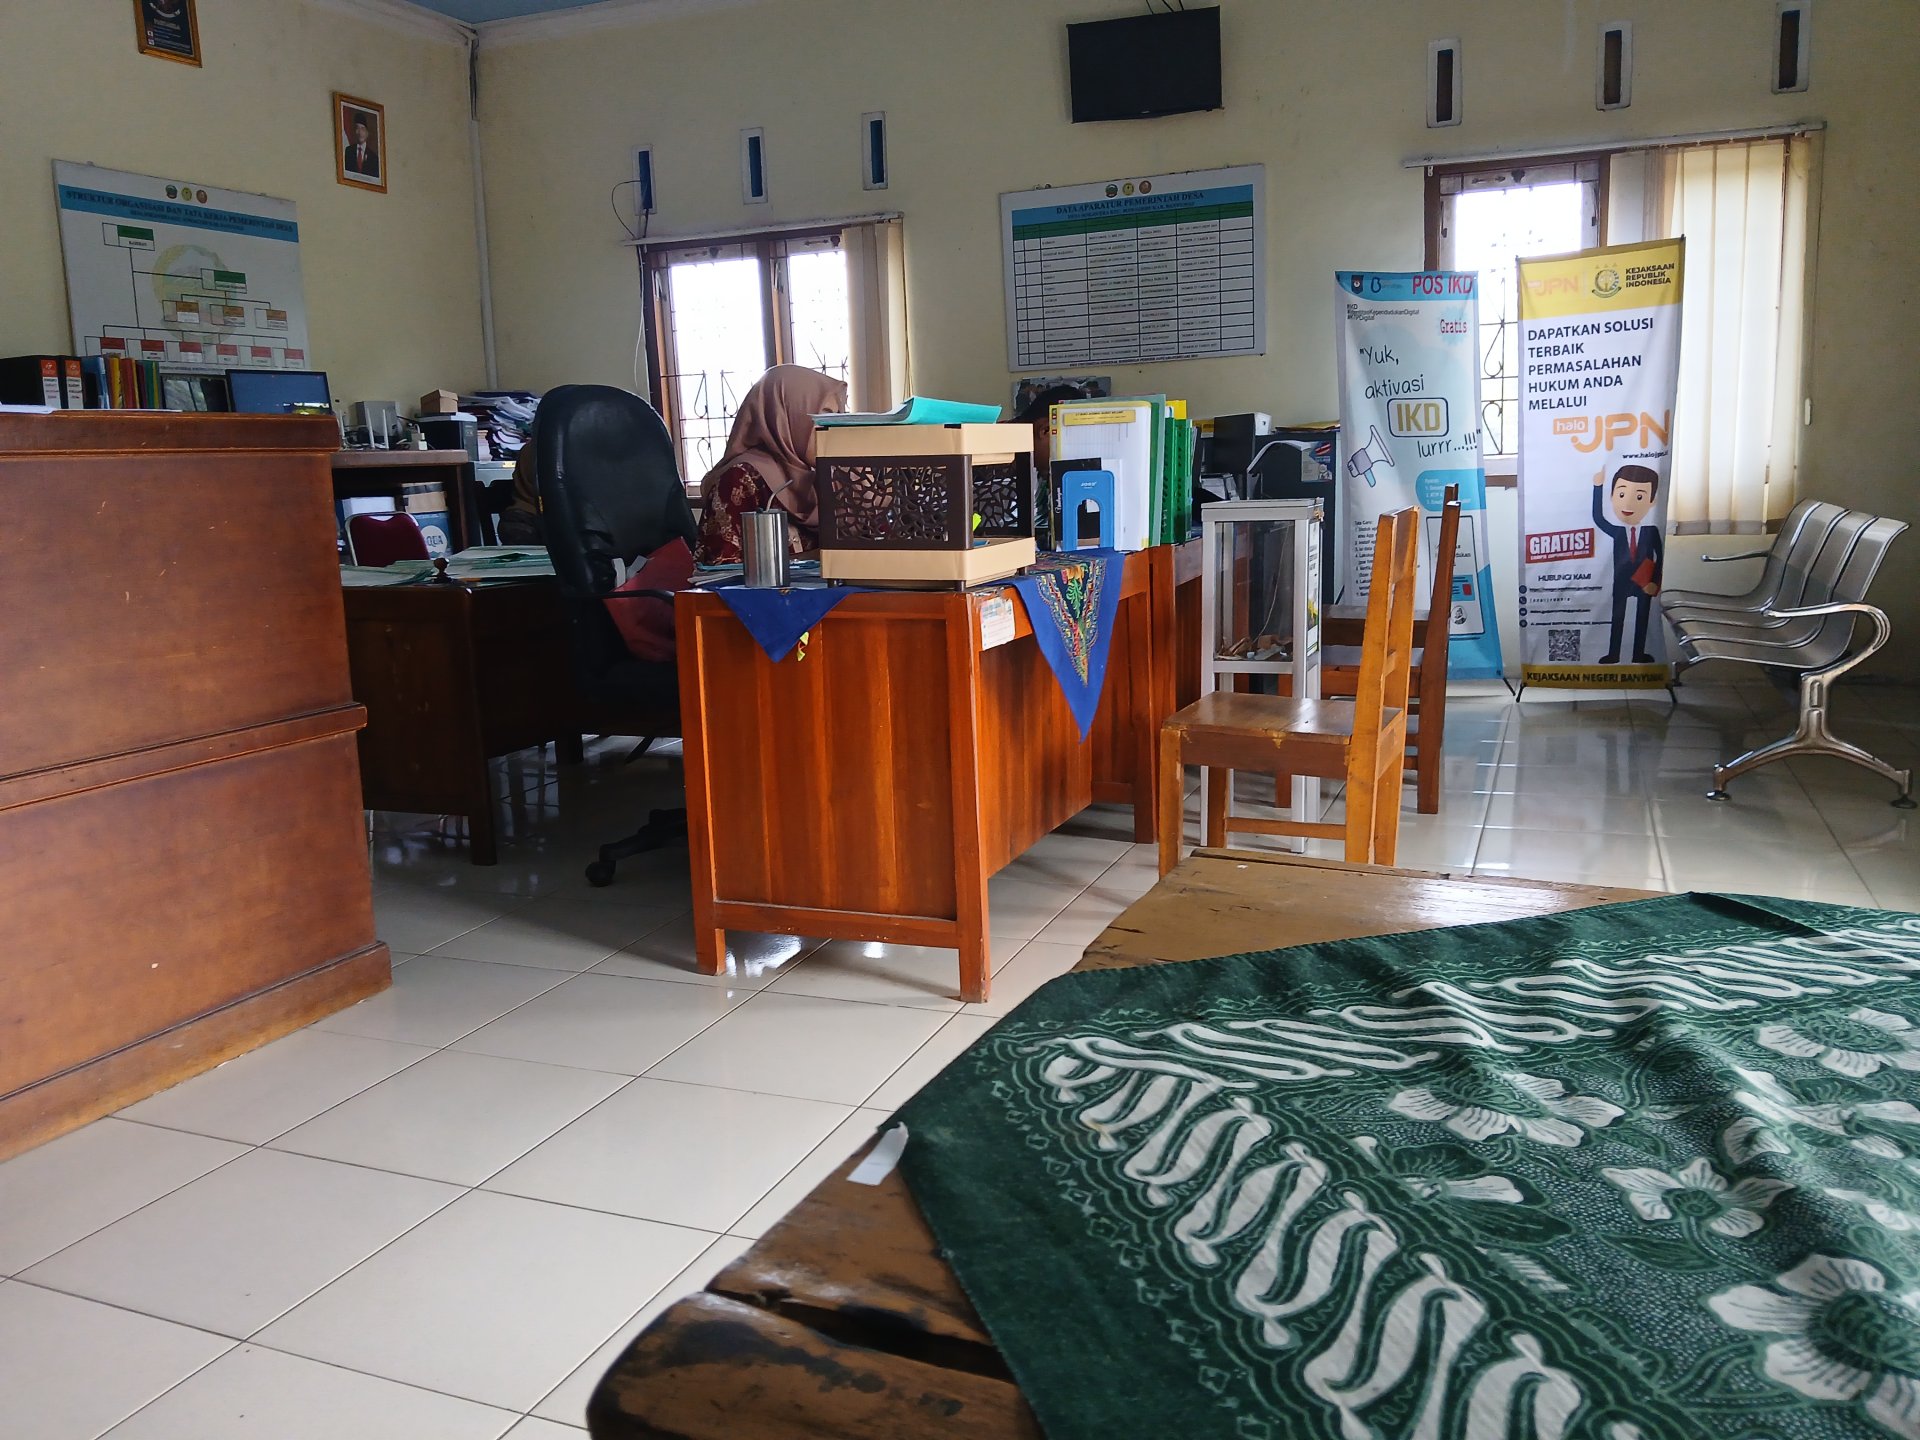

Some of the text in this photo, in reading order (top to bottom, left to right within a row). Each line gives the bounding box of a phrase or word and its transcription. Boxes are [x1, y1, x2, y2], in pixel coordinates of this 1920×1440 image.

[1056, 206, 1077, 214] DATA
[1079, 200, 1122, 213] APARATUR
[1124, 194, 1180, 207] PEMERINTAH
[1181, 192, 1204, 201] DESA
[1626, 262, 1675, 275] KEJAKSAAN
[1626, 271, 1666, 282] REPUBLIK
[1412, 274, 1473, 295] POS IKD
[1626, 277, 1671, 288] INDONESIA
[1440, 318, 1468, 334] Gratis
[1528, 317, 1654, 341] DAPATKAN SOLUSI
[1528, 342, 1585, 358] TERBAIK
[1528, 355, 1642, 376] PERMASALAHAN
[1365, 374, 1425, 400] aktivasi
[1528, 375, 1623, 393] HUKUM ANDA
[1528, 395, 1588, 411] MELALUI
[1396, 402, 1441, 432] IKD
[1556, 418, 1586, 432] halo
[1570, 409, 1671, 454] JPN
[425, 535, 444, 547] QUA
[1529, 534, 1590, 555] GRATIS!
[1537, 573, 1592, 582] HUBUNGI KAMI
[1526, 671, 1580, 682] KEJAKSAAN
[1582, 672, 1618, 683] NEGERI
